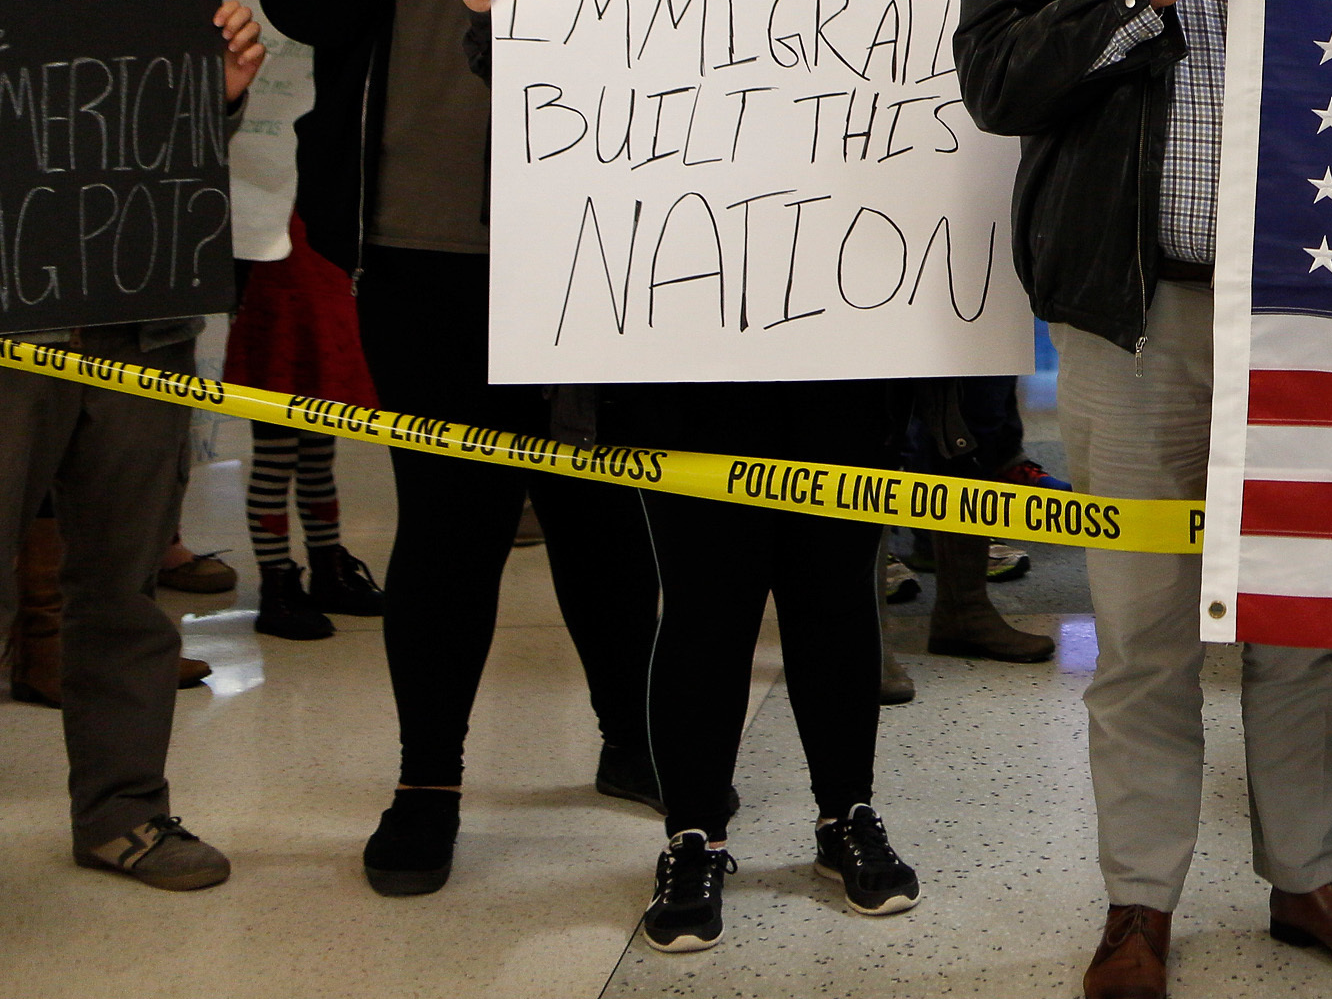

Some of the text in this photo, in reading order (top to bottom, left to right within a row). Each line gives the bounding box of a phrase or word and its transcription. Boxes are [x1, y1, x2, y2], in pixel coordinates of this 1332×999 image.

[523, 82, 963, 171] BUILT THIS
[79, 179, 230, 296] POT?
[554, 189, 997, 347] NATION
[33, 345, 66, 371] DO
[286, 395, 668, 483] POLICE LINE DO NOT CROSS
[726, 459, 1122, 541] POLICE LINE DO NOT CROSS
